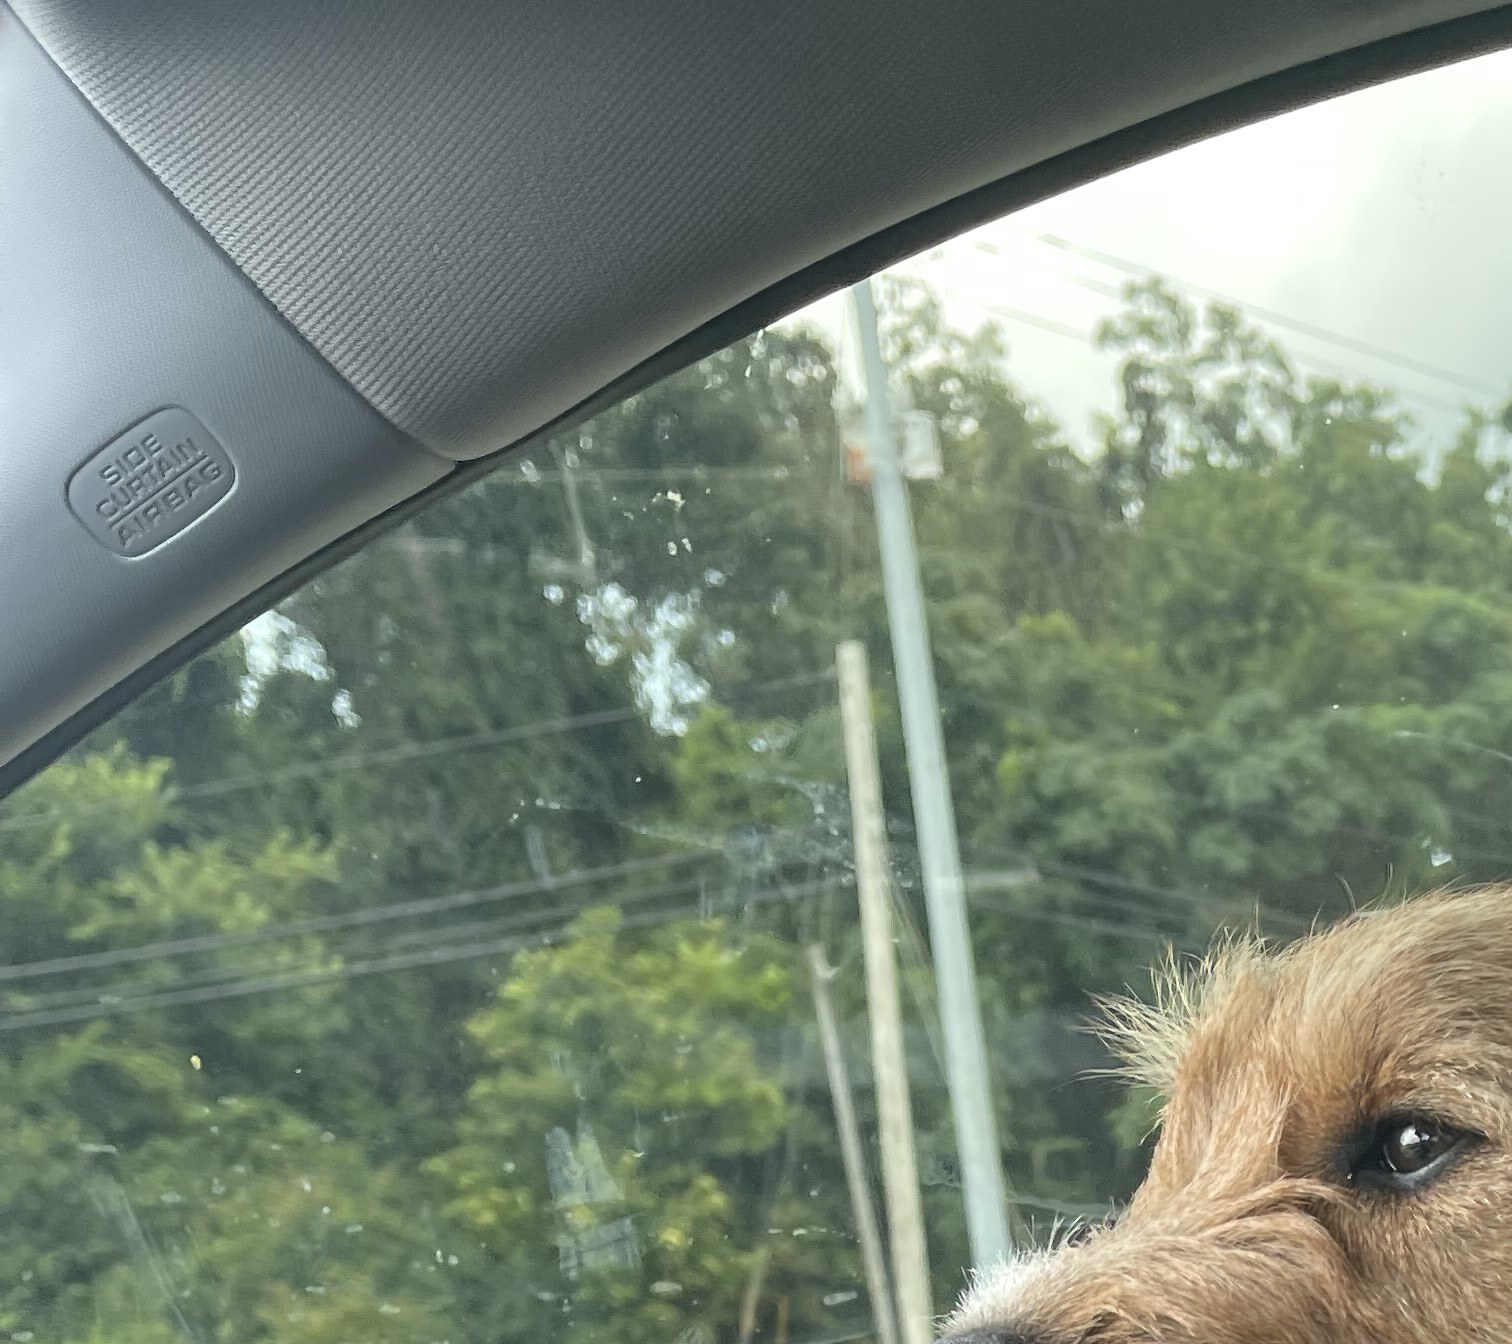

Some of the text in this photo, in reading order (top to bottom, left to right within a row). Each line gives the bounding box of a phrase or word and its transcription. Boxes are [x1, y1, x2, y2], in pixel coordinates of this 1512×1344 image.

[96, 437, 203, 517] CURTAIN
[101, 433, 164, 487] SIDE
[118, 460, 222, 546] AIRBAG
